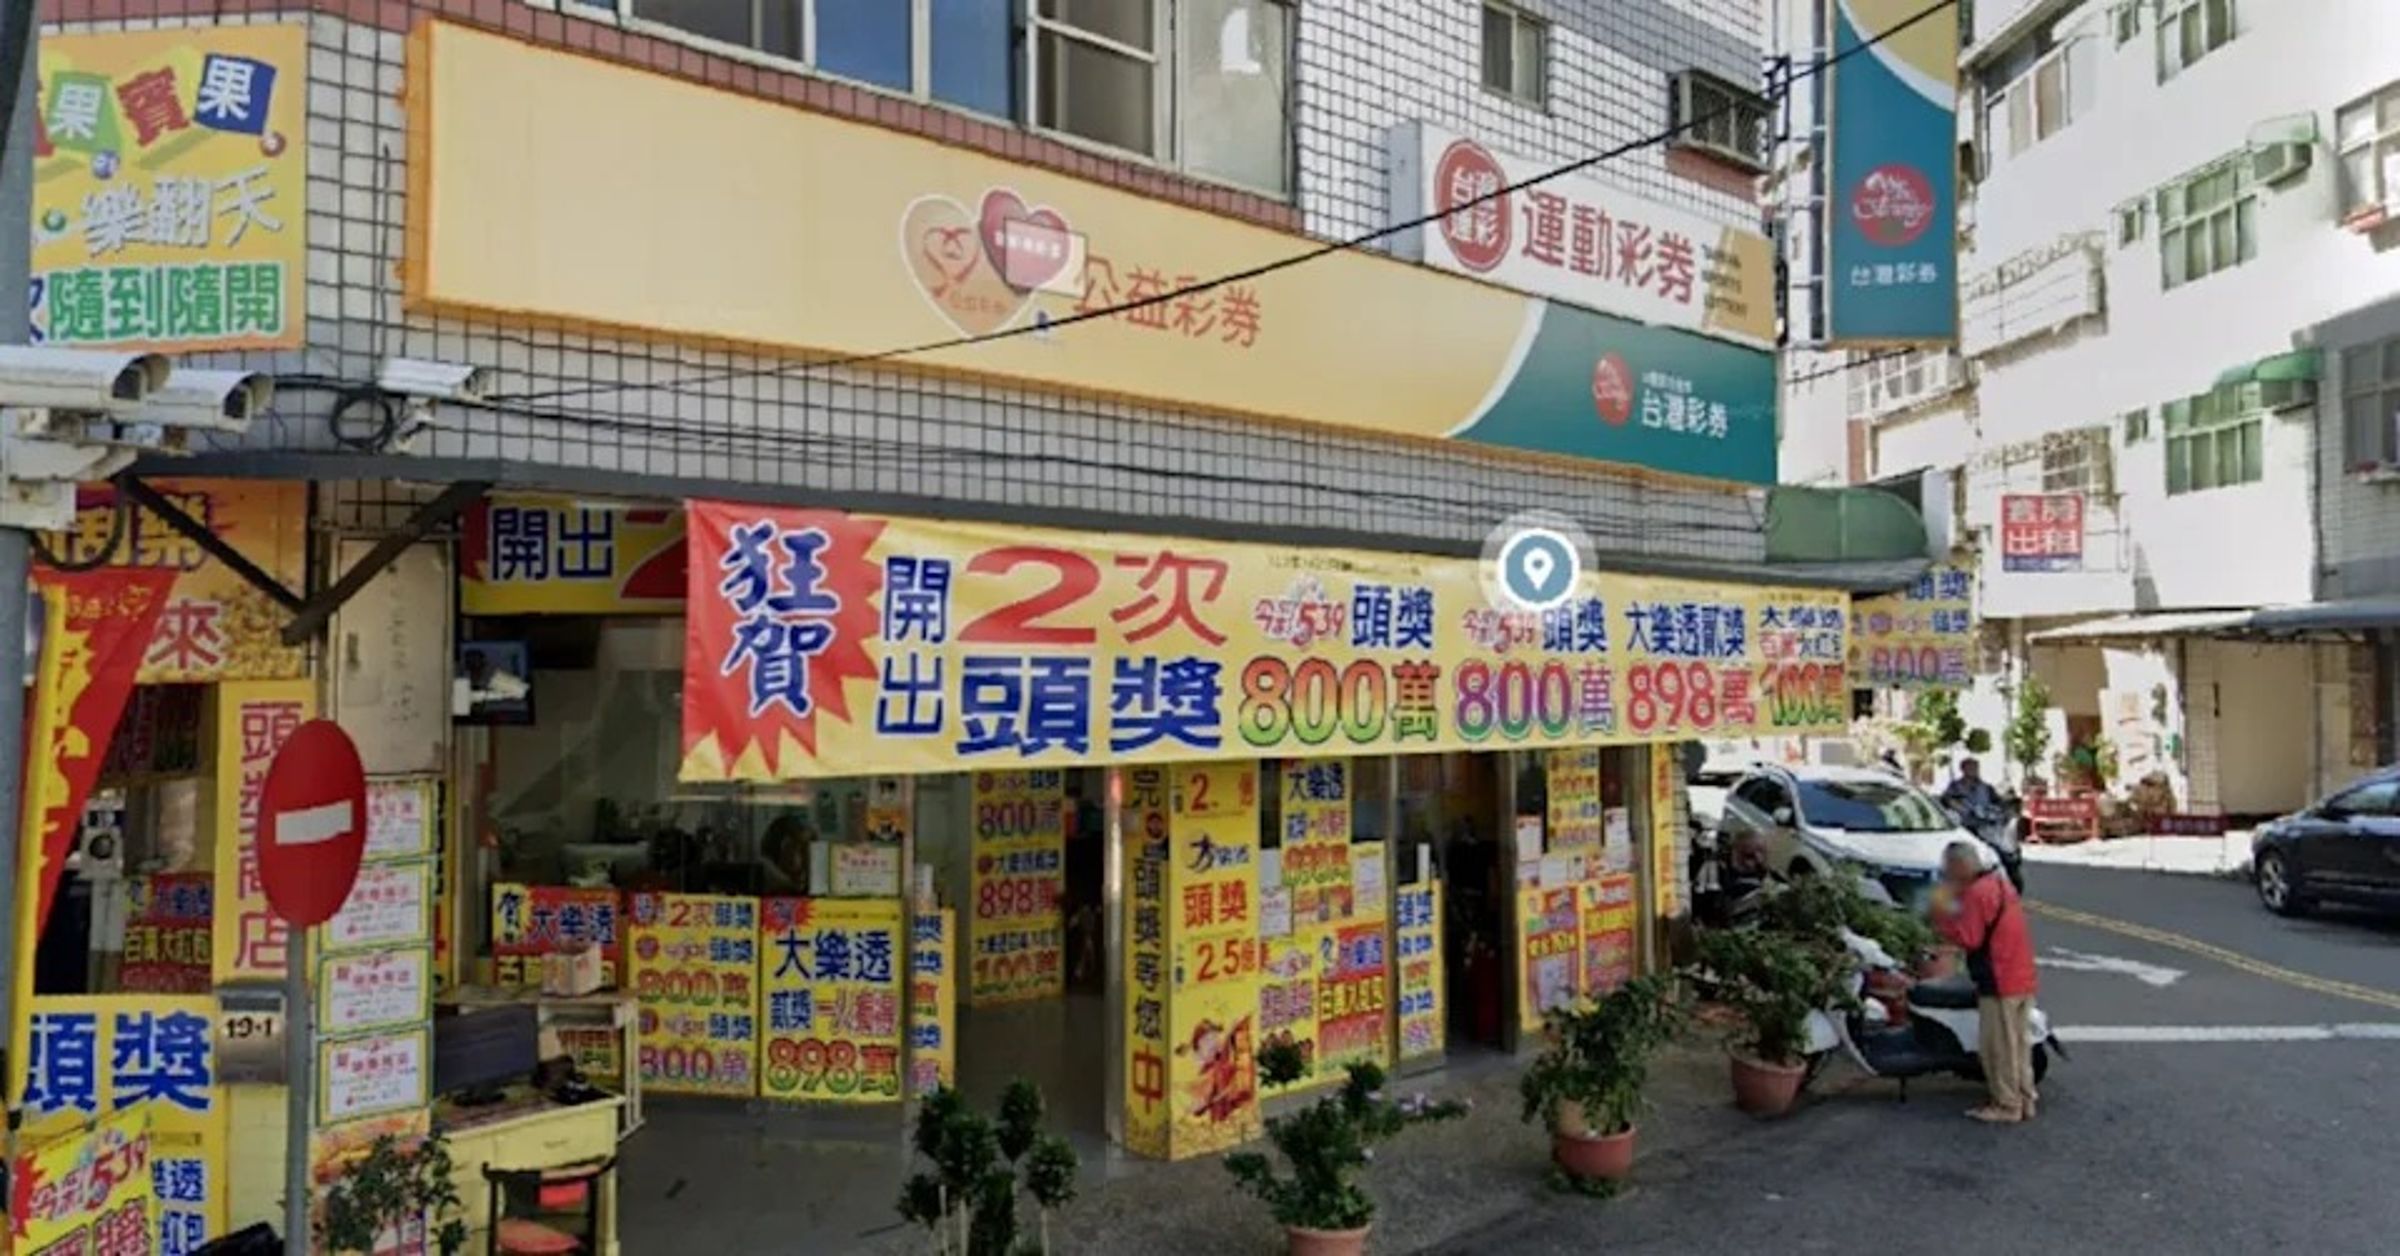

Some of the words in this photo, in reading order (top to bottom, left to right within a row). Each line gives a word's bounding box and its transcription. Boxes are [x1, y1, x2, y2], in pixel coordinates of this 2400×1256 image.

[82, 167, 283, 258] 樂翻天
[1521, 187, 1695, 305] 運動彩券
[1073, 254, 1261, 349] 公益彩券
[1642, 389, 1728, 439] 台灣彩券
[148, 599, 220, 670] 來
[718, 520, 840, 716] 狂賀
[956, 546, 1230, 646] 2次
[1351, 584, 1435, 649] 頭獎
[1543, 597, 1608, 652] 頭獎
[876, 555, 951, 735] 開出
[955, 655, 1222, 757] 頭獎
[1239, 655, 1441, 747] 800萬
[1456, 658, 1615, 742] 800萬
[1627, 660, 1755, 733] 898萬
[977, 879, 1058, 919] 898萬
[1184, 879, 1247, 929] 頭獎
[775, 929, 892, 983] 大樂透
[23, 1011, 212, 1113] 頭獎
[767, 1037, 899, 1098] 898萬
